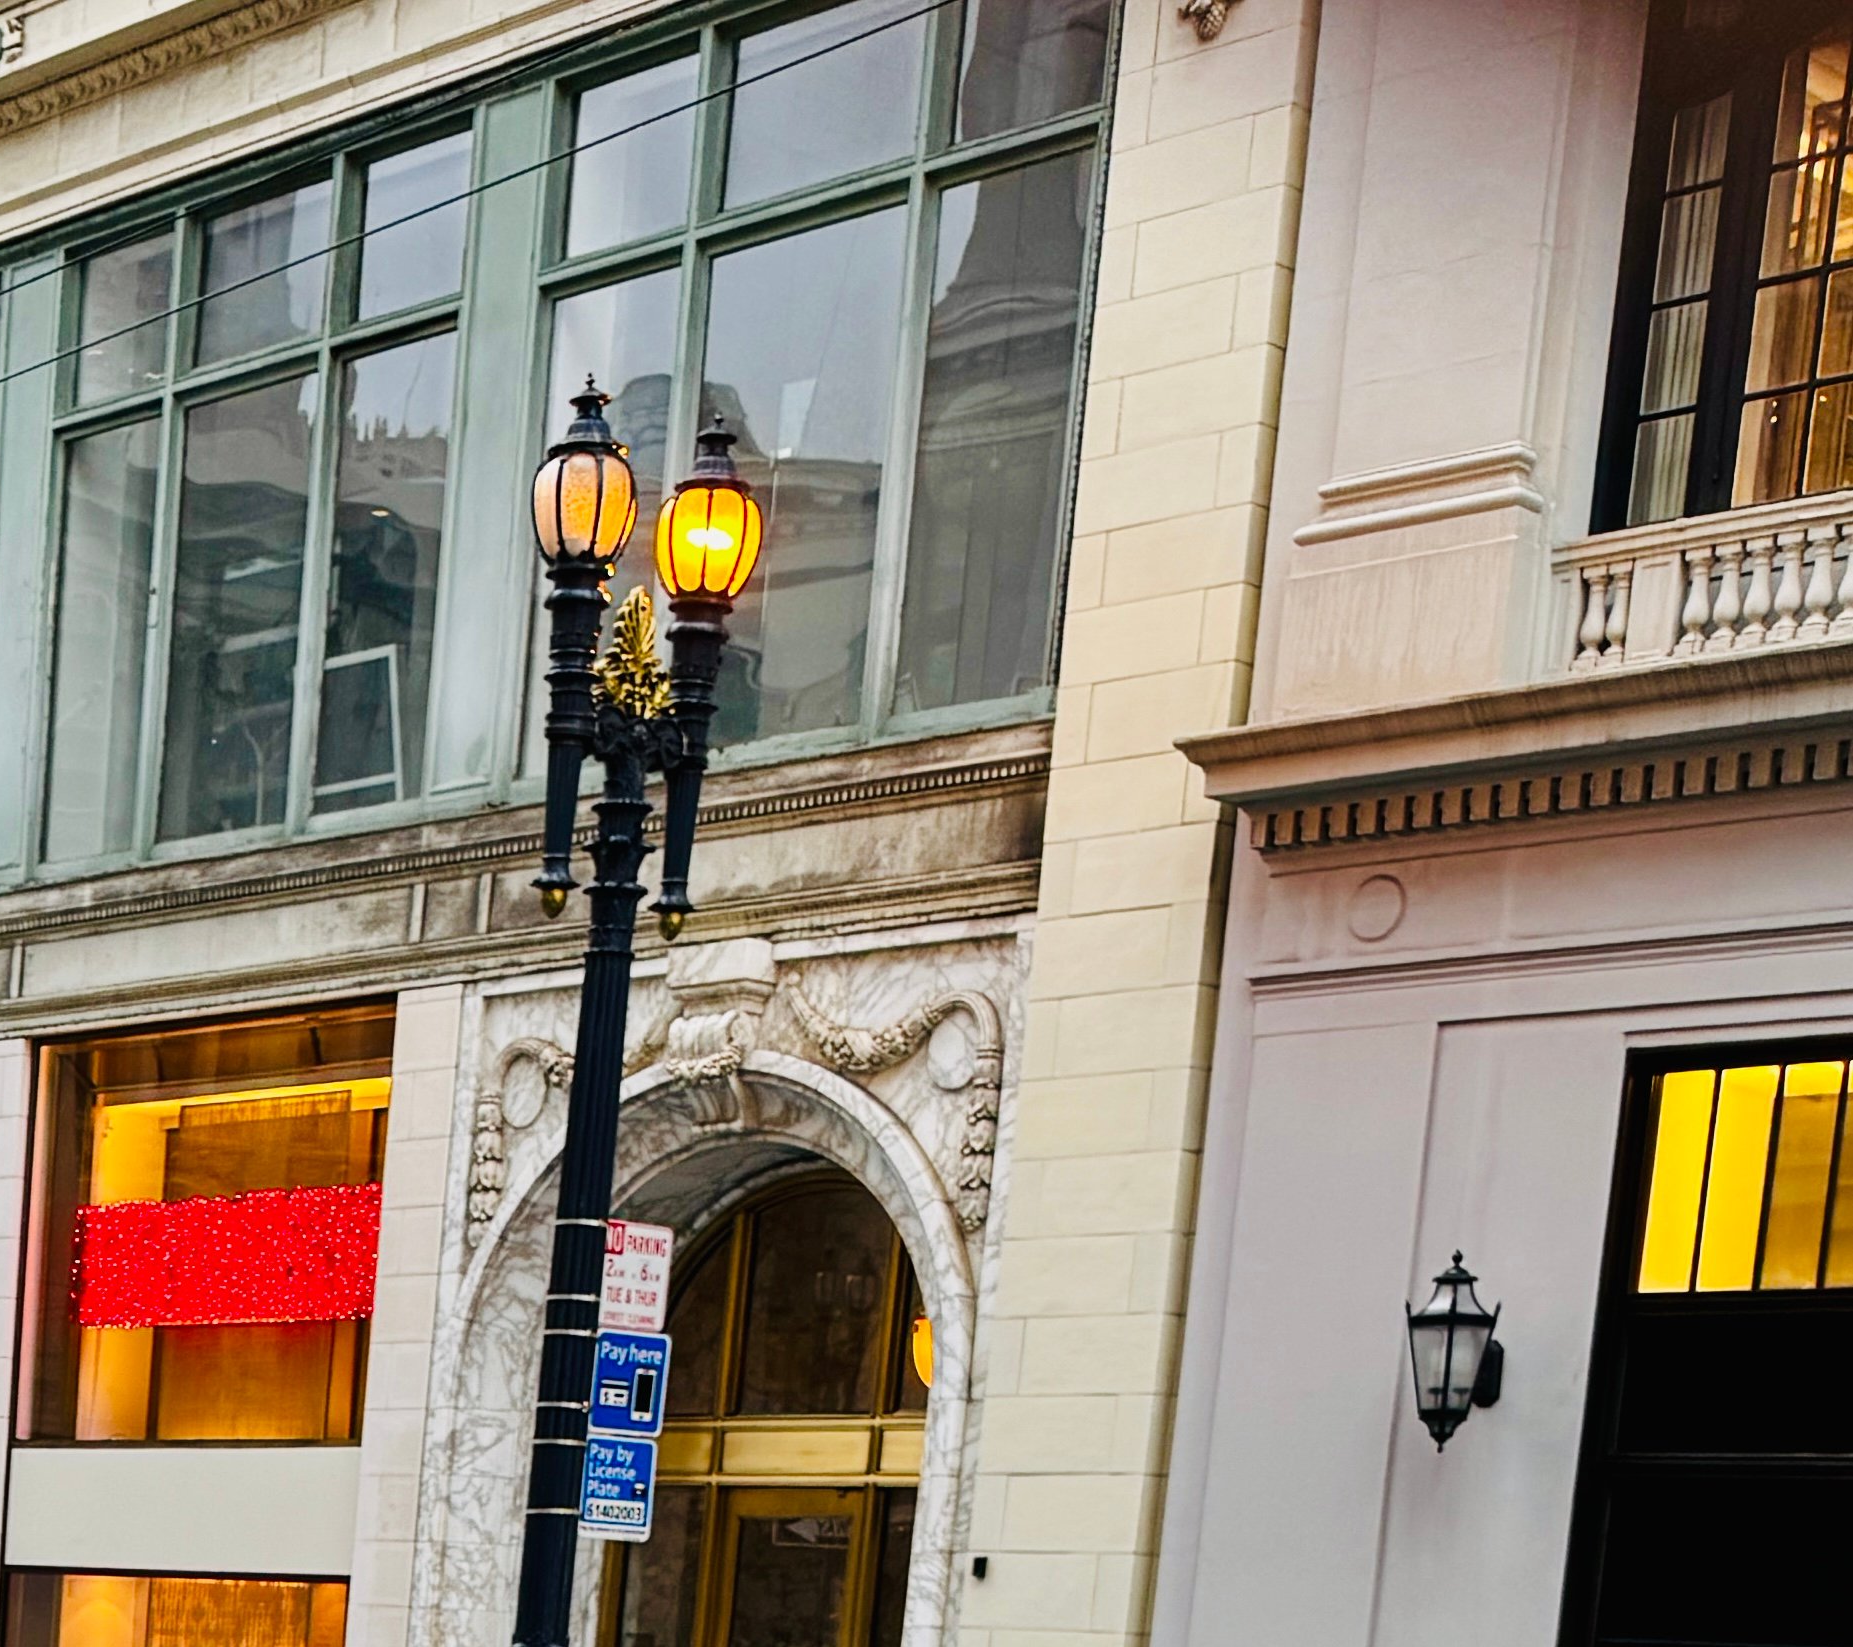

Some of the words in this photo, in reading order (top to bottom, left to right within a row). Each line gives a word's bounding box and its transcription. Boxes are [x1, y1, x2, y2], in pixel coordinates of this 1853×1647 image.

[627, 1234, 667, 1258] PARKING
[606, 1285, 623, 1304] TUE
[635, 1289, 657, 1307] THUR
[600, 1340, 628, 1366] Pay
[628, 1343, 663, 1365] here
[589, 1443, 615, 1464] Pay
[616, 1444, 635, 1466] by
[588, 1461, 637, 1482] License
[586, 1479, 621, 1498] Plate
